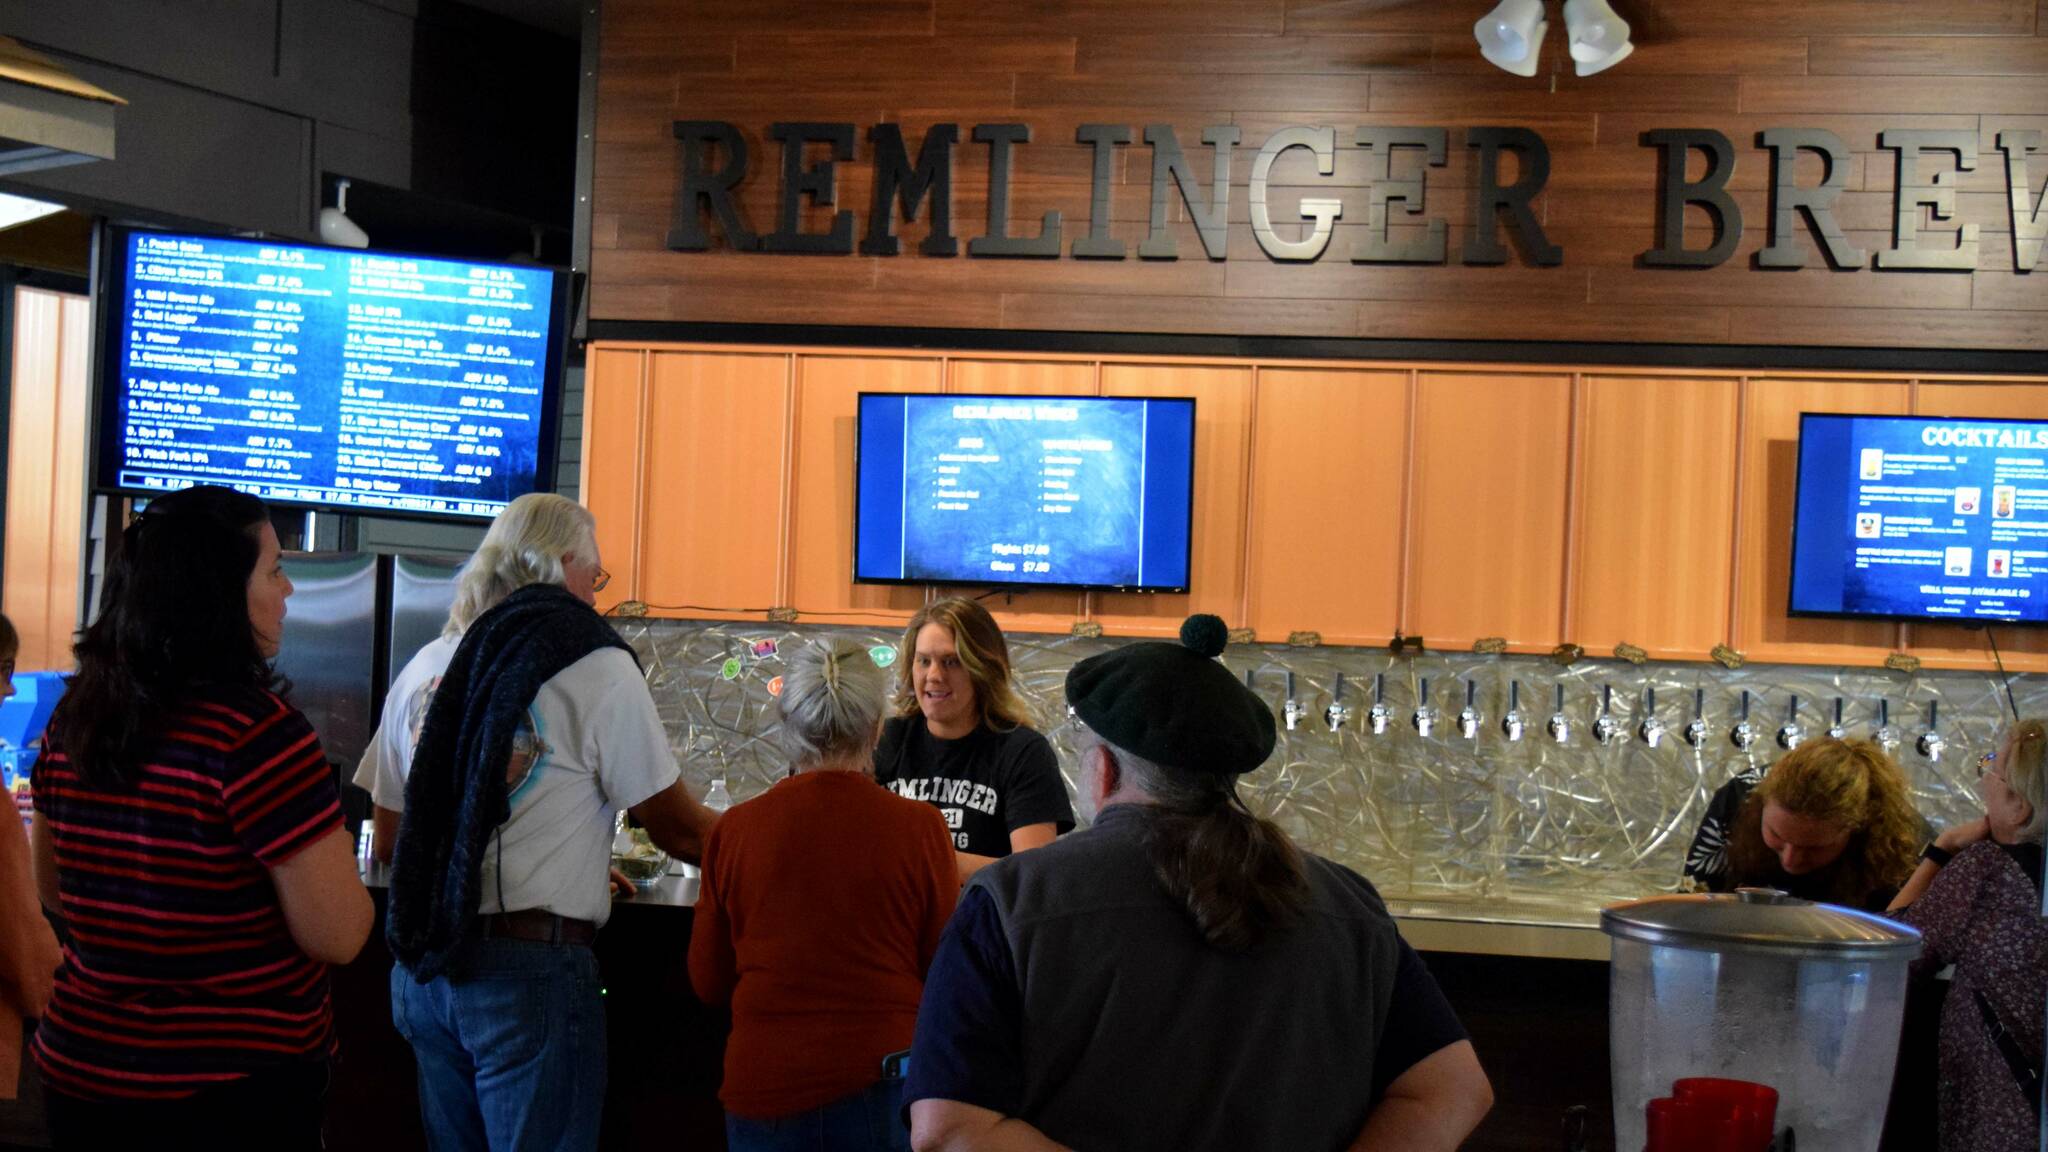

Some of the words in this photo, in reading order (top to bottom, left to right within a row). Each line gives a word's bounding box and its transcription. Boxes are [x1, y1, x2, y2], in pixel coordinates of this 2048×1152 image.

[667, 121, 1562, 264] REMLINGER
[1922, 426, 2048, 449] COCKTAILS
[881, 776, 998, 815] MLINGER
